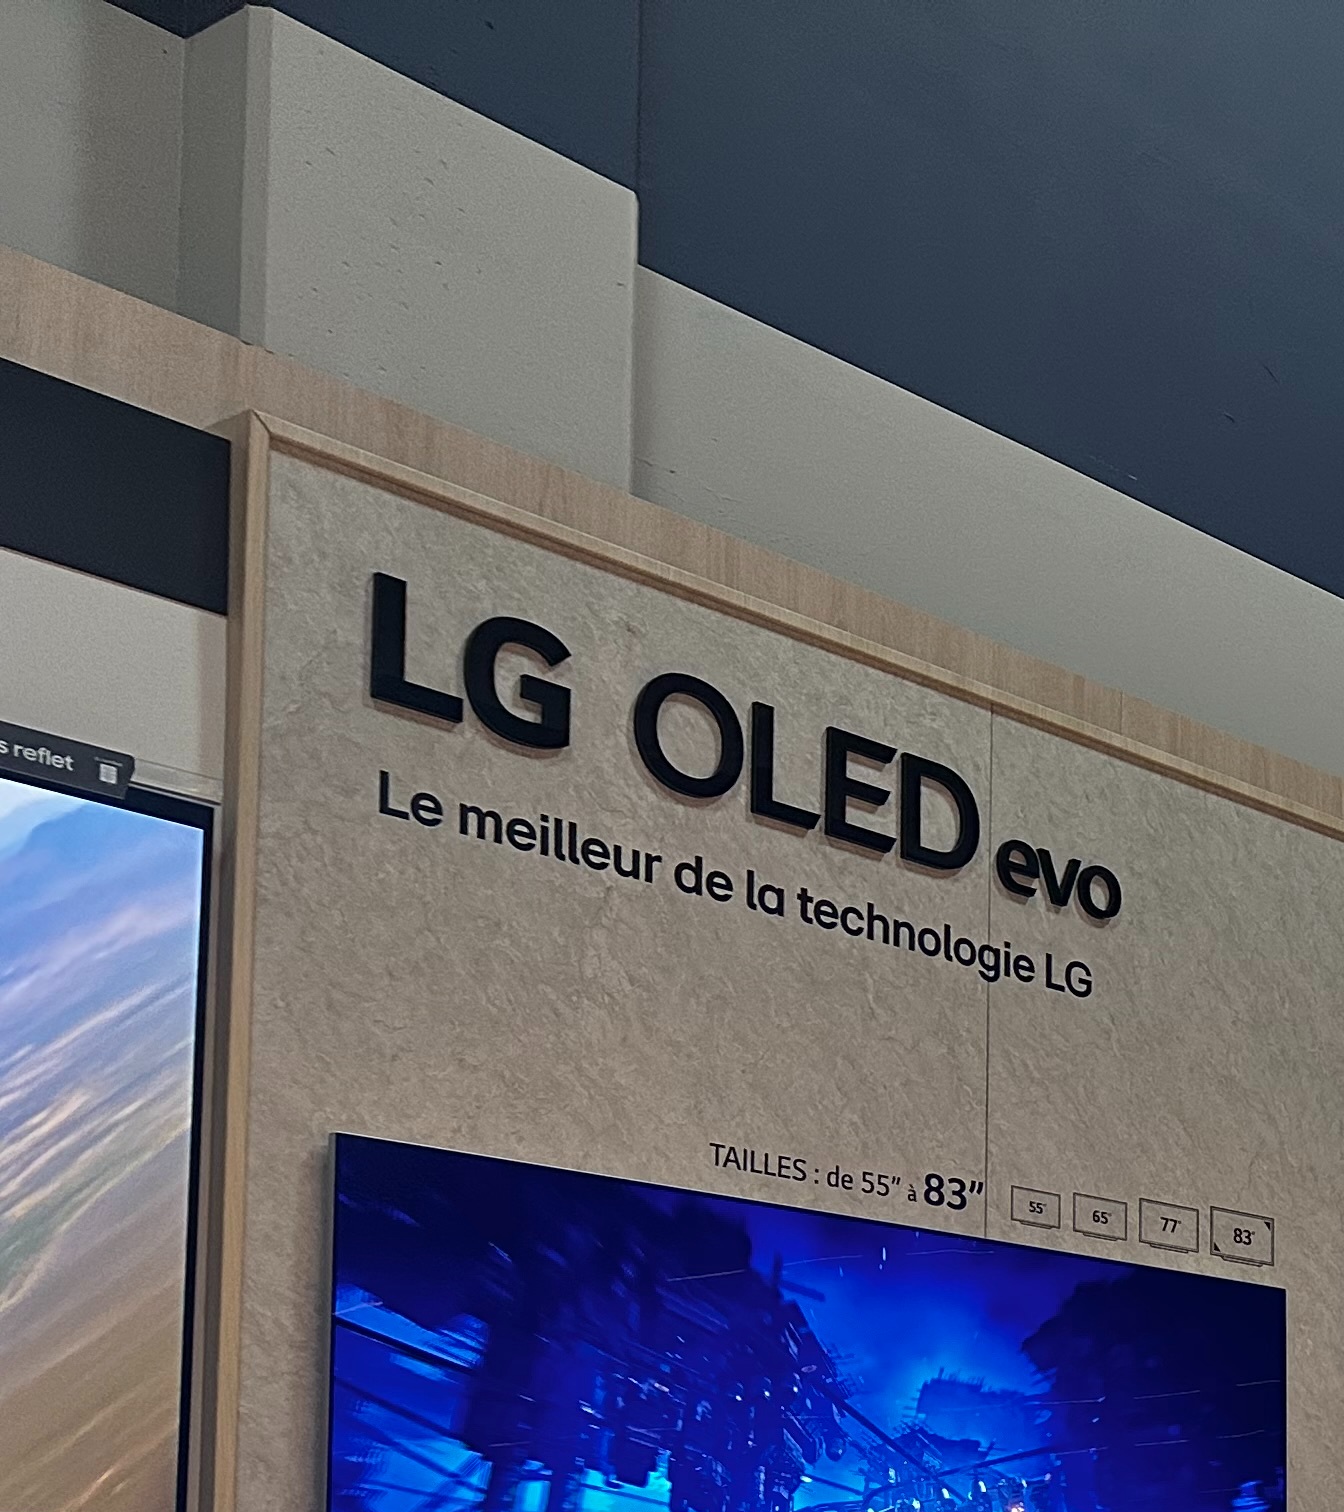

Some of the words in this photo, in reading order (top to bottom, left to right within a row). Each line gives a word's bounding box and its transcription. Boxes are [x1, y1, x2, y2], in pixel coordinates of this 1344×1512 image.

[13, 743, 75, 772] reflet
[369, 572, 572, 750] LG
[633, 671, 981, 870] OLED
[995, 838, 1123, 920] evo
[378, 770, 444, 827] Le
[458, 800, 663, 884] meilleur
[674, 854, 735, 902] de
[746, 869, 786, 917] la
[796, 885, 1036, 982] technologie
[1045, 952, 1093, 999] LG
[709, 1142, 808, 1182] TAILLES
[826, 1165, 854, 1190] de
[906, 1184, 918, 1204] à
